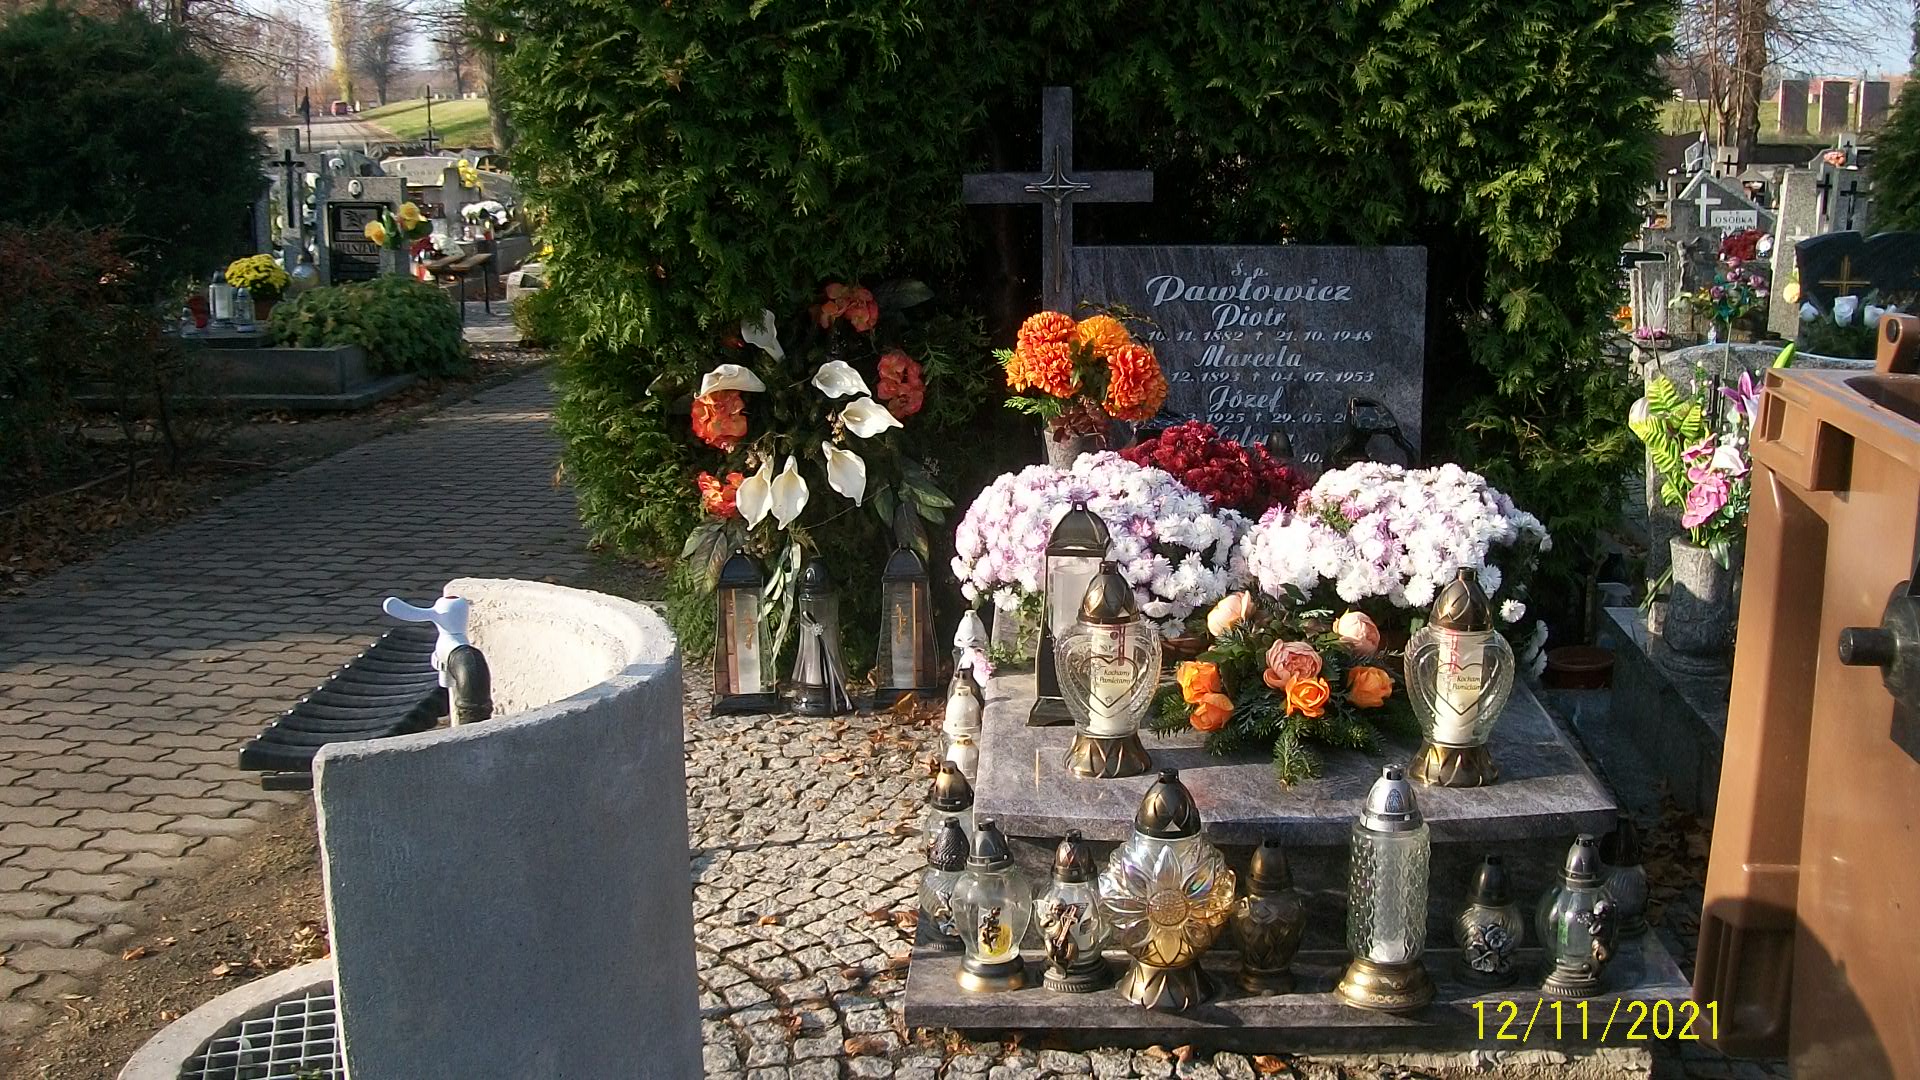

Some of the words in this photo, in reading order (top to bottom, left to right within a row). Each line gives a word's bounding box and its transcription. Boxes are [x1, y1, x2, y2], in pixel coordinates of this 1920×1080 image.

[1145, 275, 1353, 307] Pawłowicz
[1211, 303, 1287, 331] Piotr
[1176, 330, 1198, 342] 11.
[1202, 330, 1245, 342] 1882
[1275, 330, 1298, 342] 21.
[1303, 330, 1326, 342] 10.
[1332, 330, 1375, 342] 1948
[1193, 345, 1303, 369] Marcela
[1171, 371, 1195, 383] 12.
[1304, 371, 1329, 382] 07.
[1335, 371, 1375, 383] 1953
[1208, 385, 1285, 413] Józef
[1206, 411, 1246, 423] 1925
[1271, 411, 1297, 423] 29.
[1301, 411, 1327, 423] 05.
